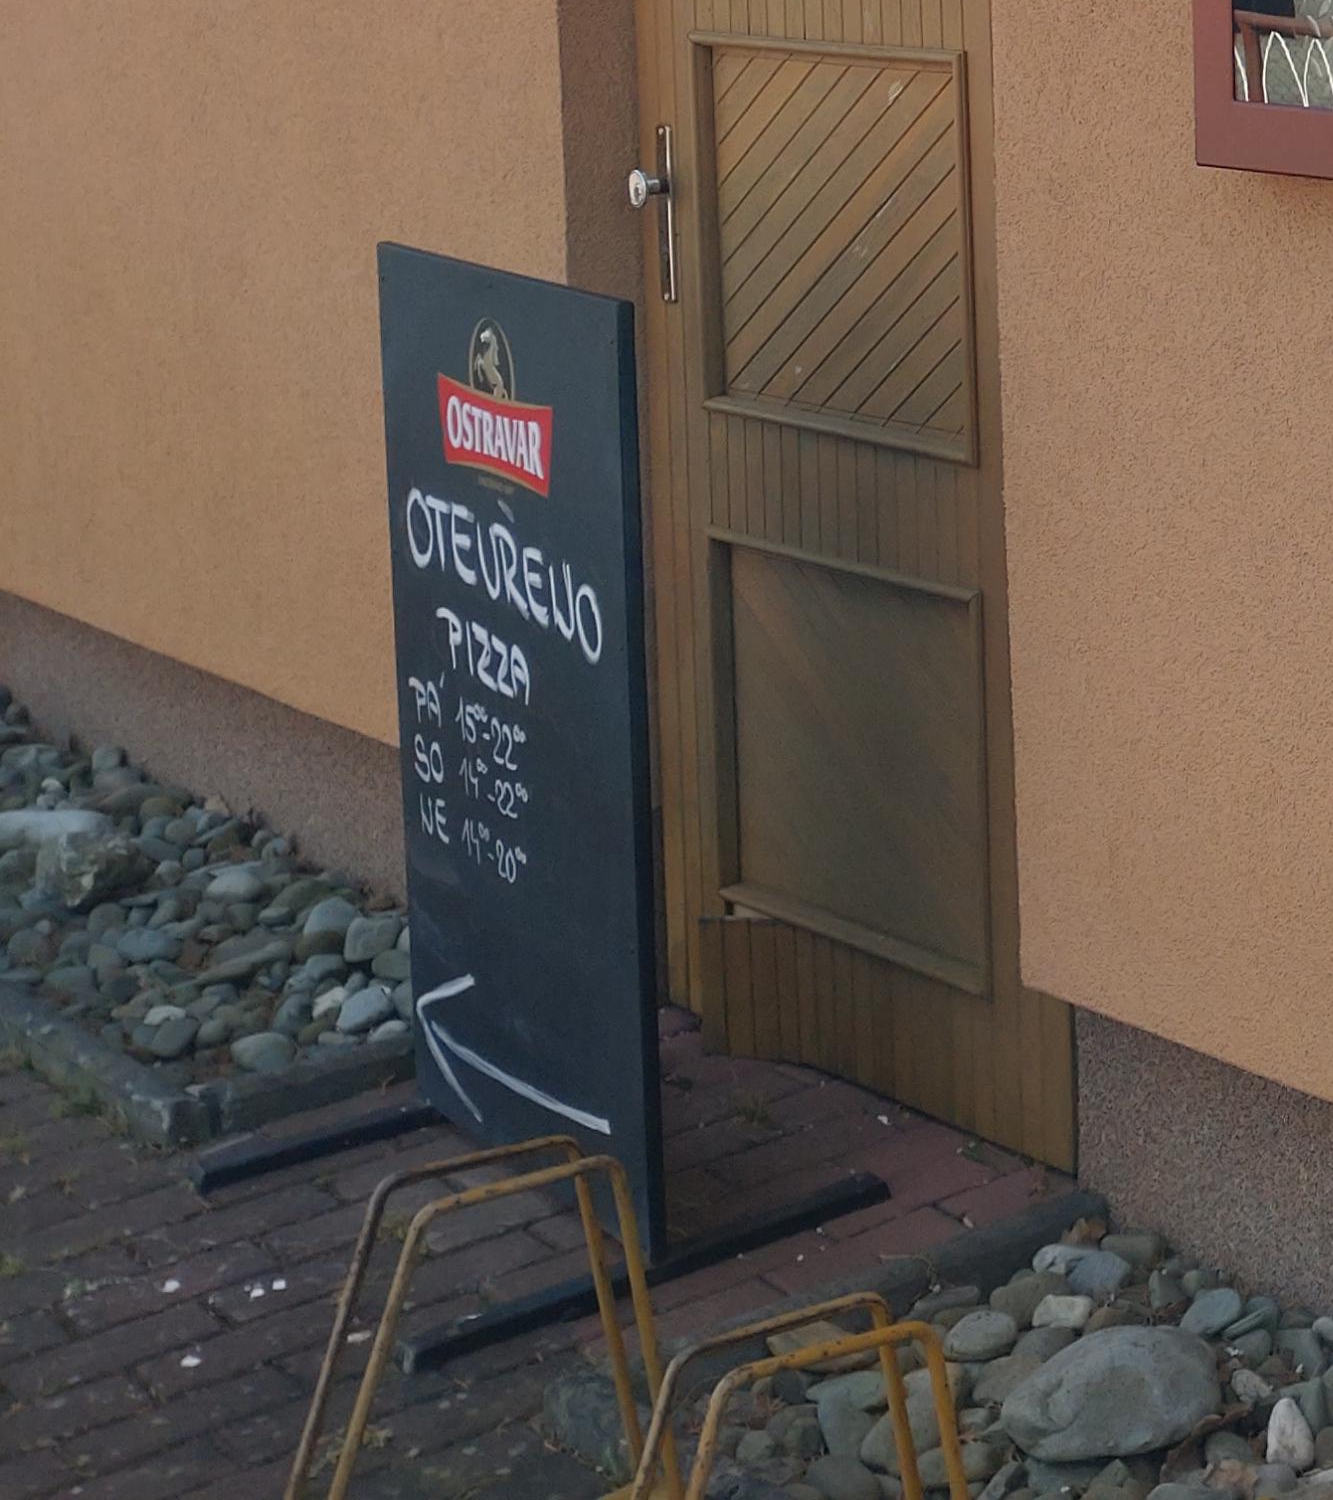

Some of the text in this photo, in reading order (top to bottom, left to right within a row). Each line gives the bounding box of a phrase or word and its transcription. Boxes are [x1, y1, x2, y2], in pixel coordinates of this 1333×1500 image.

[447, 395, 544, 479] OSTRAVAR
[436, 607, 531, 706] PIZZA
[408, 672, 445, 728] PÁ
[414, 734, 444, 784] SO
[419, 792, 449, 844] NE
